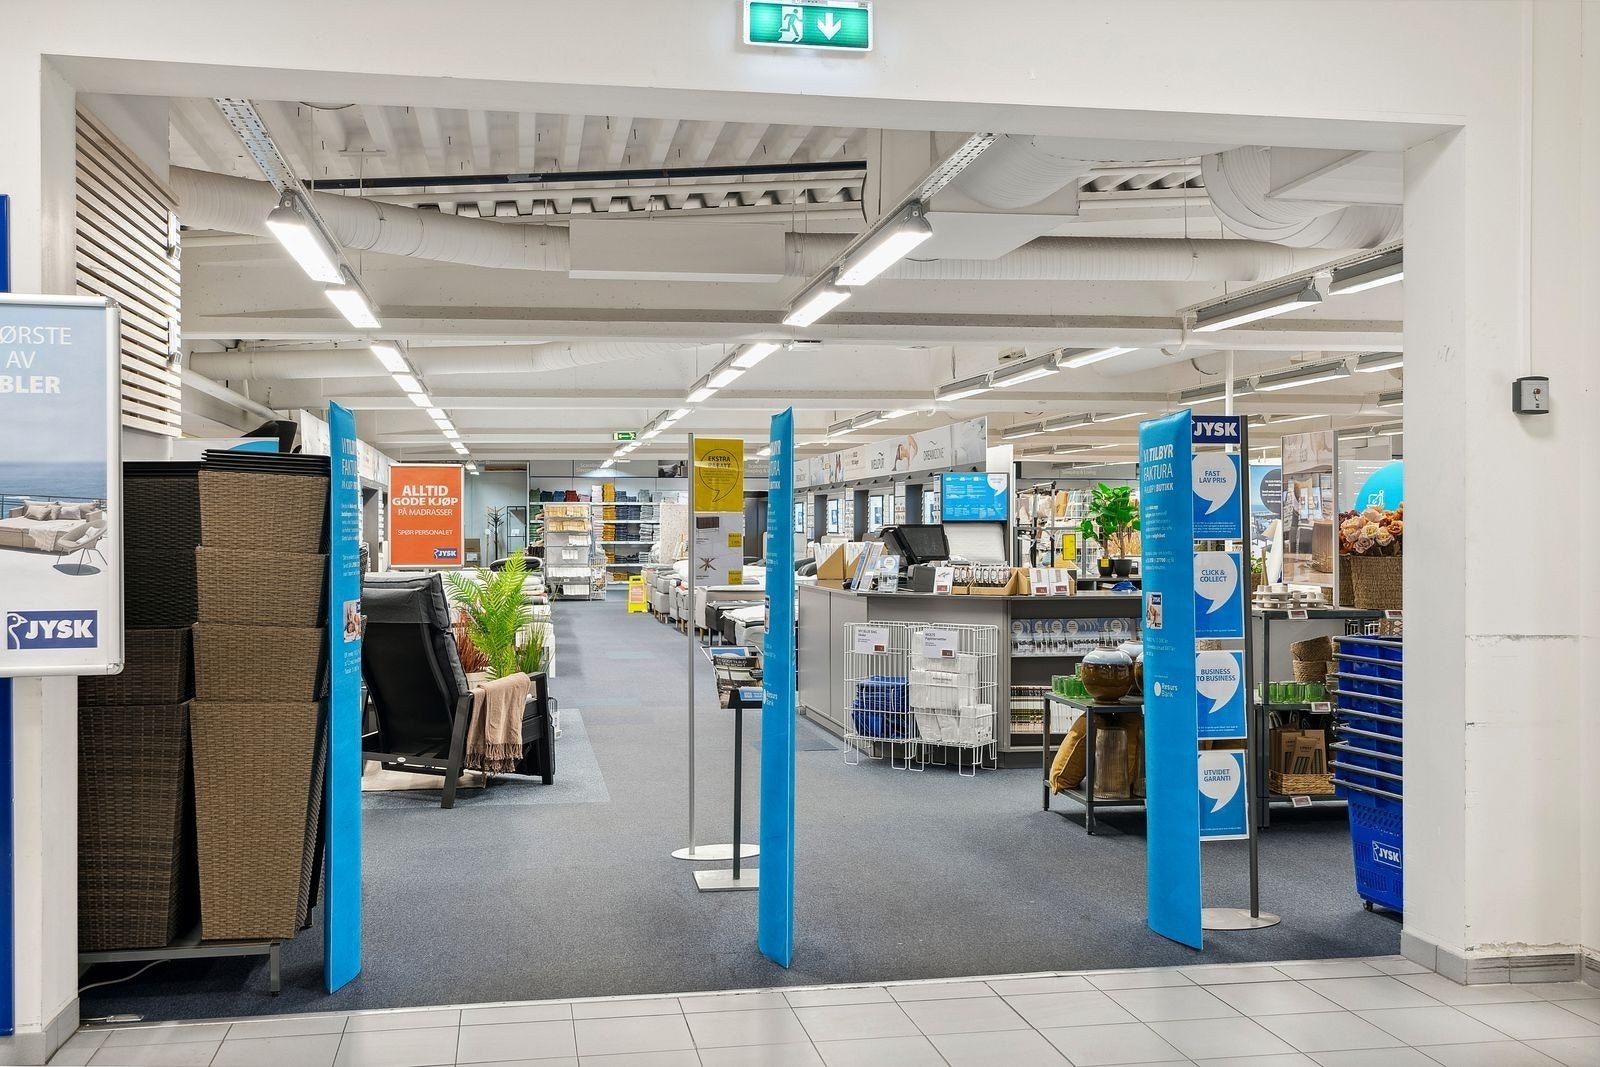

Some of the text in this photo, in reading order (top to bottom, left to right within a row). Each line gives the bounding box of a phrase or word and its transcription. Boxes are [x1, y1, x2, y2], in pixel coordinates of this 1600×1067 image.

[5, 350, 36, 369] AV
[0, 375, 61, 394] BLER
[1194, 422, 1238, 437] JYSK
[1149, 443, 1174, 462] TILBYR
[1143, 462, 1174, 481] FAKTURA
[401, 485, 449, 496] ALLTID
[392, 497, 459, 506] GODE KJØP
[398, 508, 453, 516] PÅ MADRASSER
[25, 619, 94, 640] JYSK
[1379, 847, 1400, 863] JYSK
